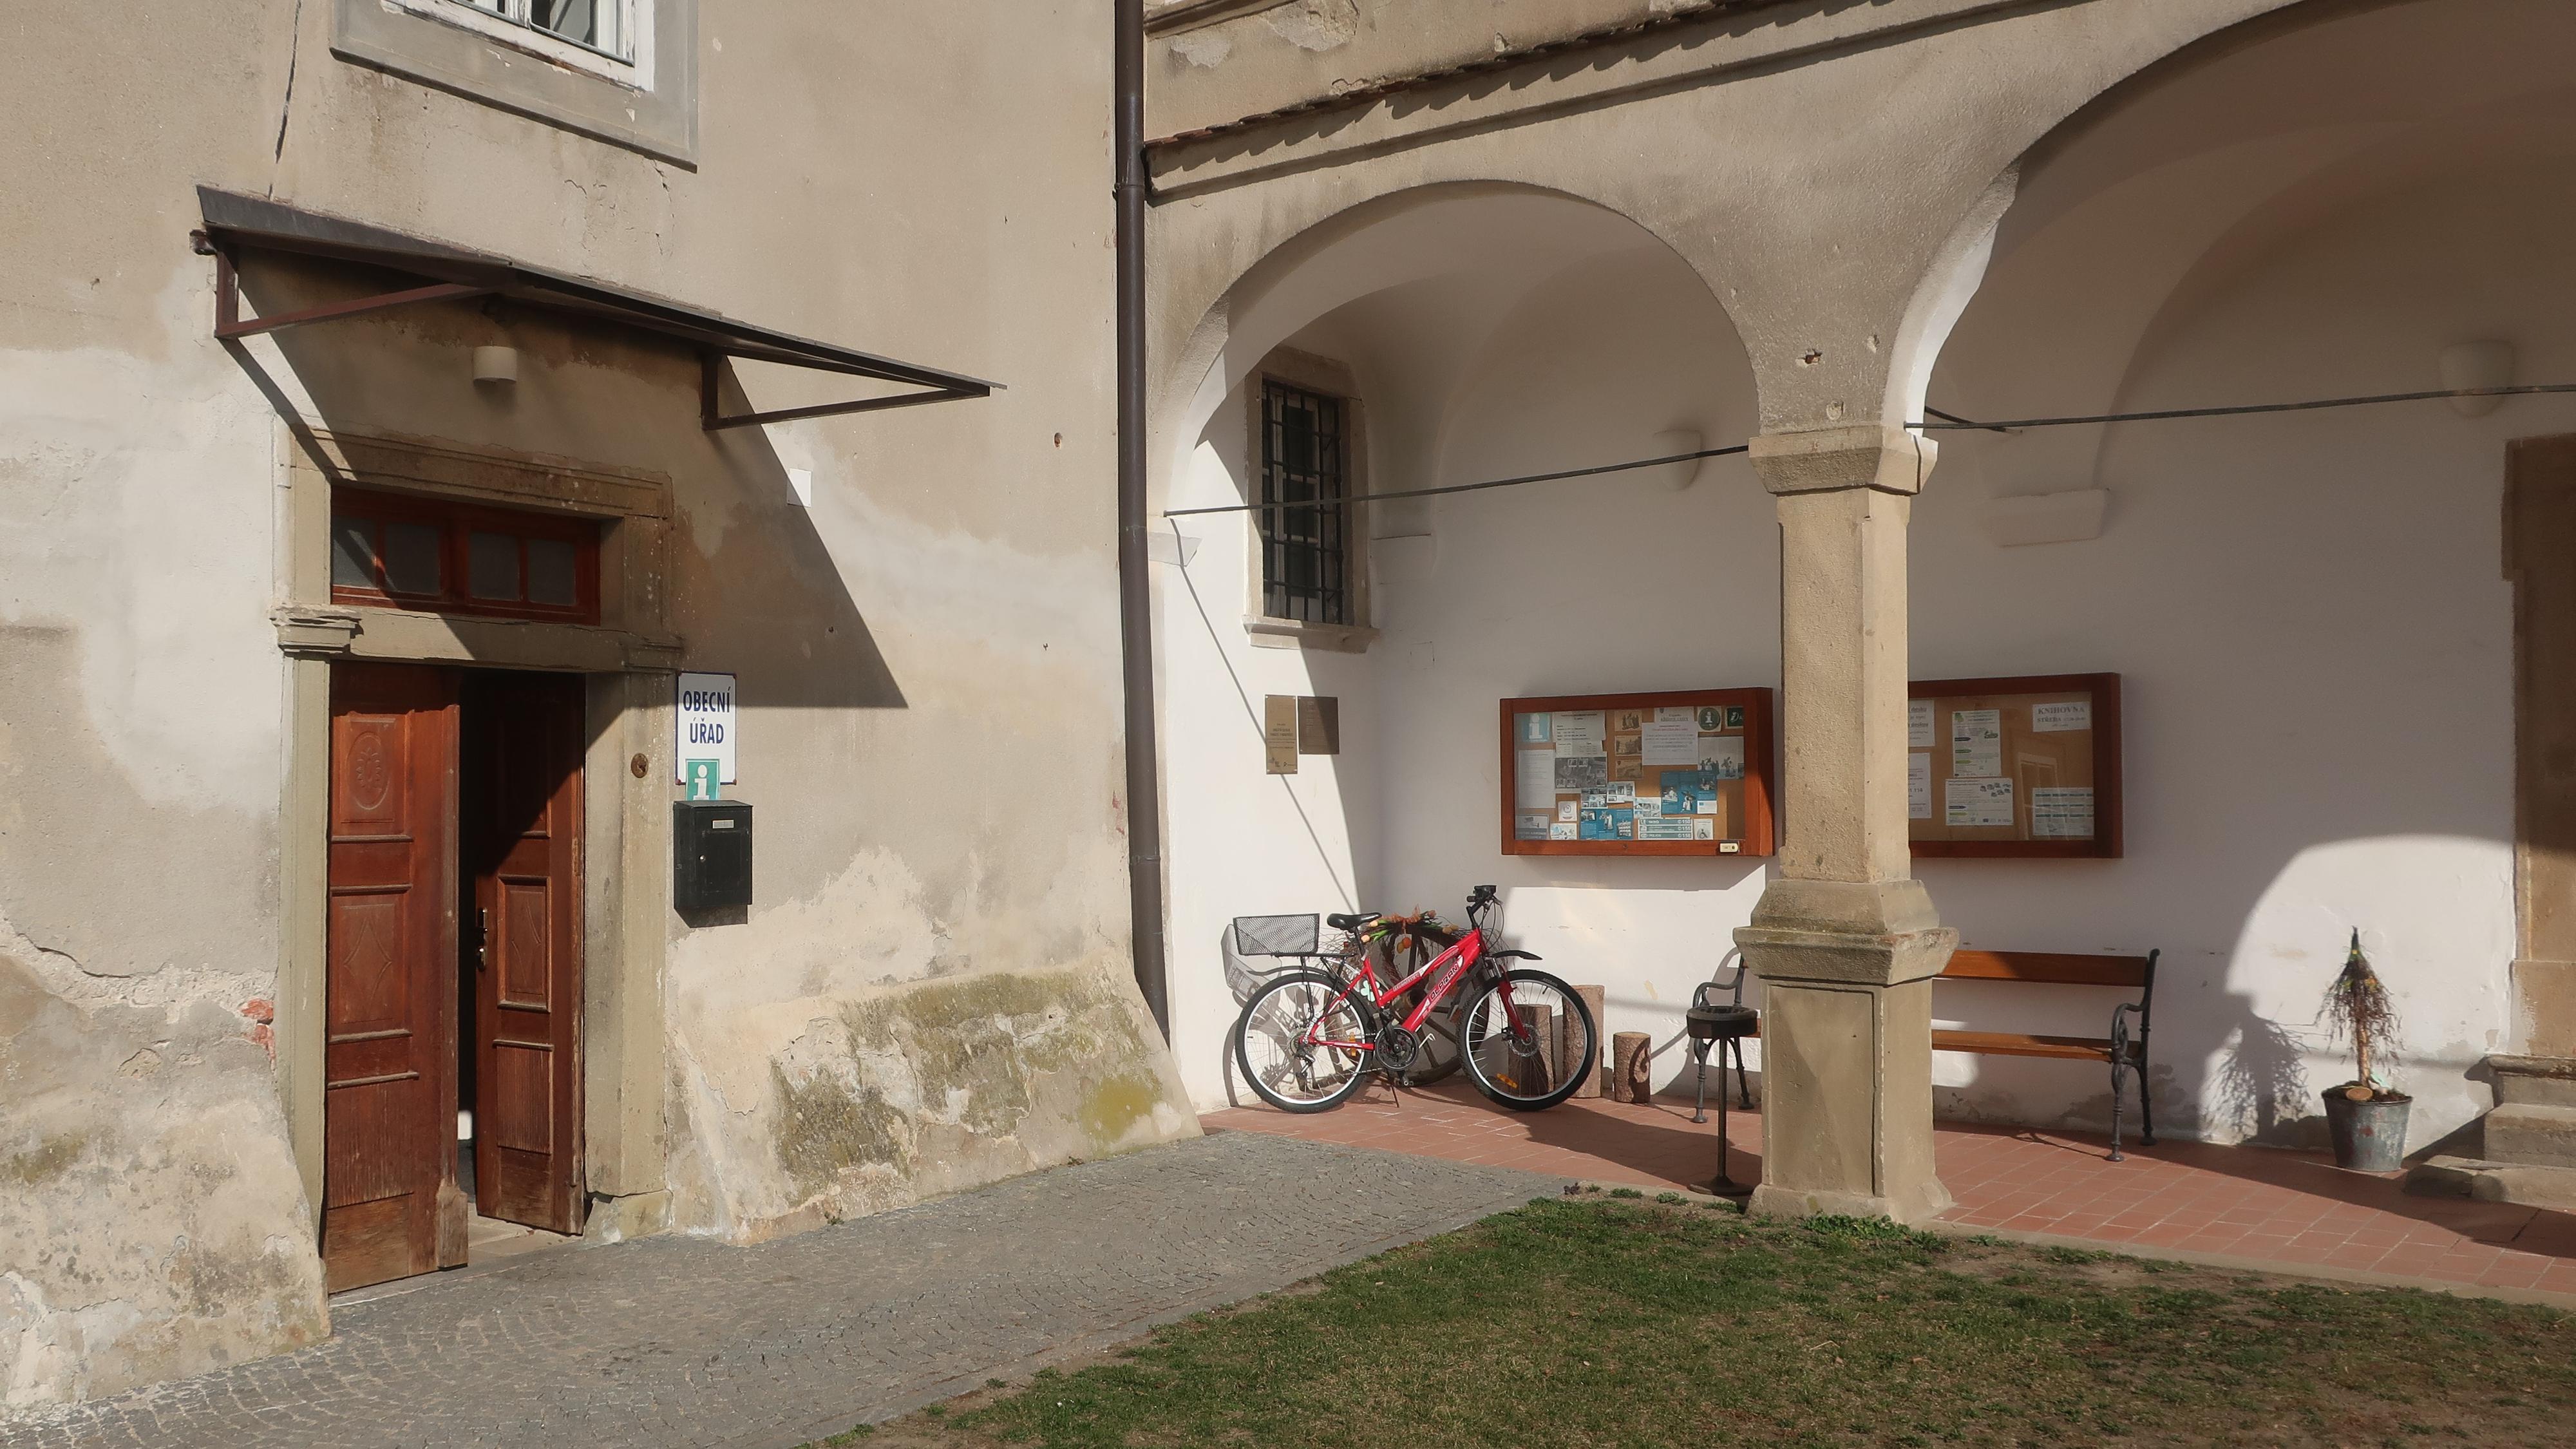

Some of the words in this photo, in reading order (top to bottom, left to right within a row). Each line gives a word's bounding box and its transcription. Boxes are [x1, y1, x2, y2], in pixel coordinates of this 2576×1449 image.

[683, 687, 731, 713] OBECNÍ
[2038, 706, 2085, 715] KNIHOVNA
[690, 717, 724, 744] ÚŘAD
[1430, 964, 1458, 1001] OLPRAN
